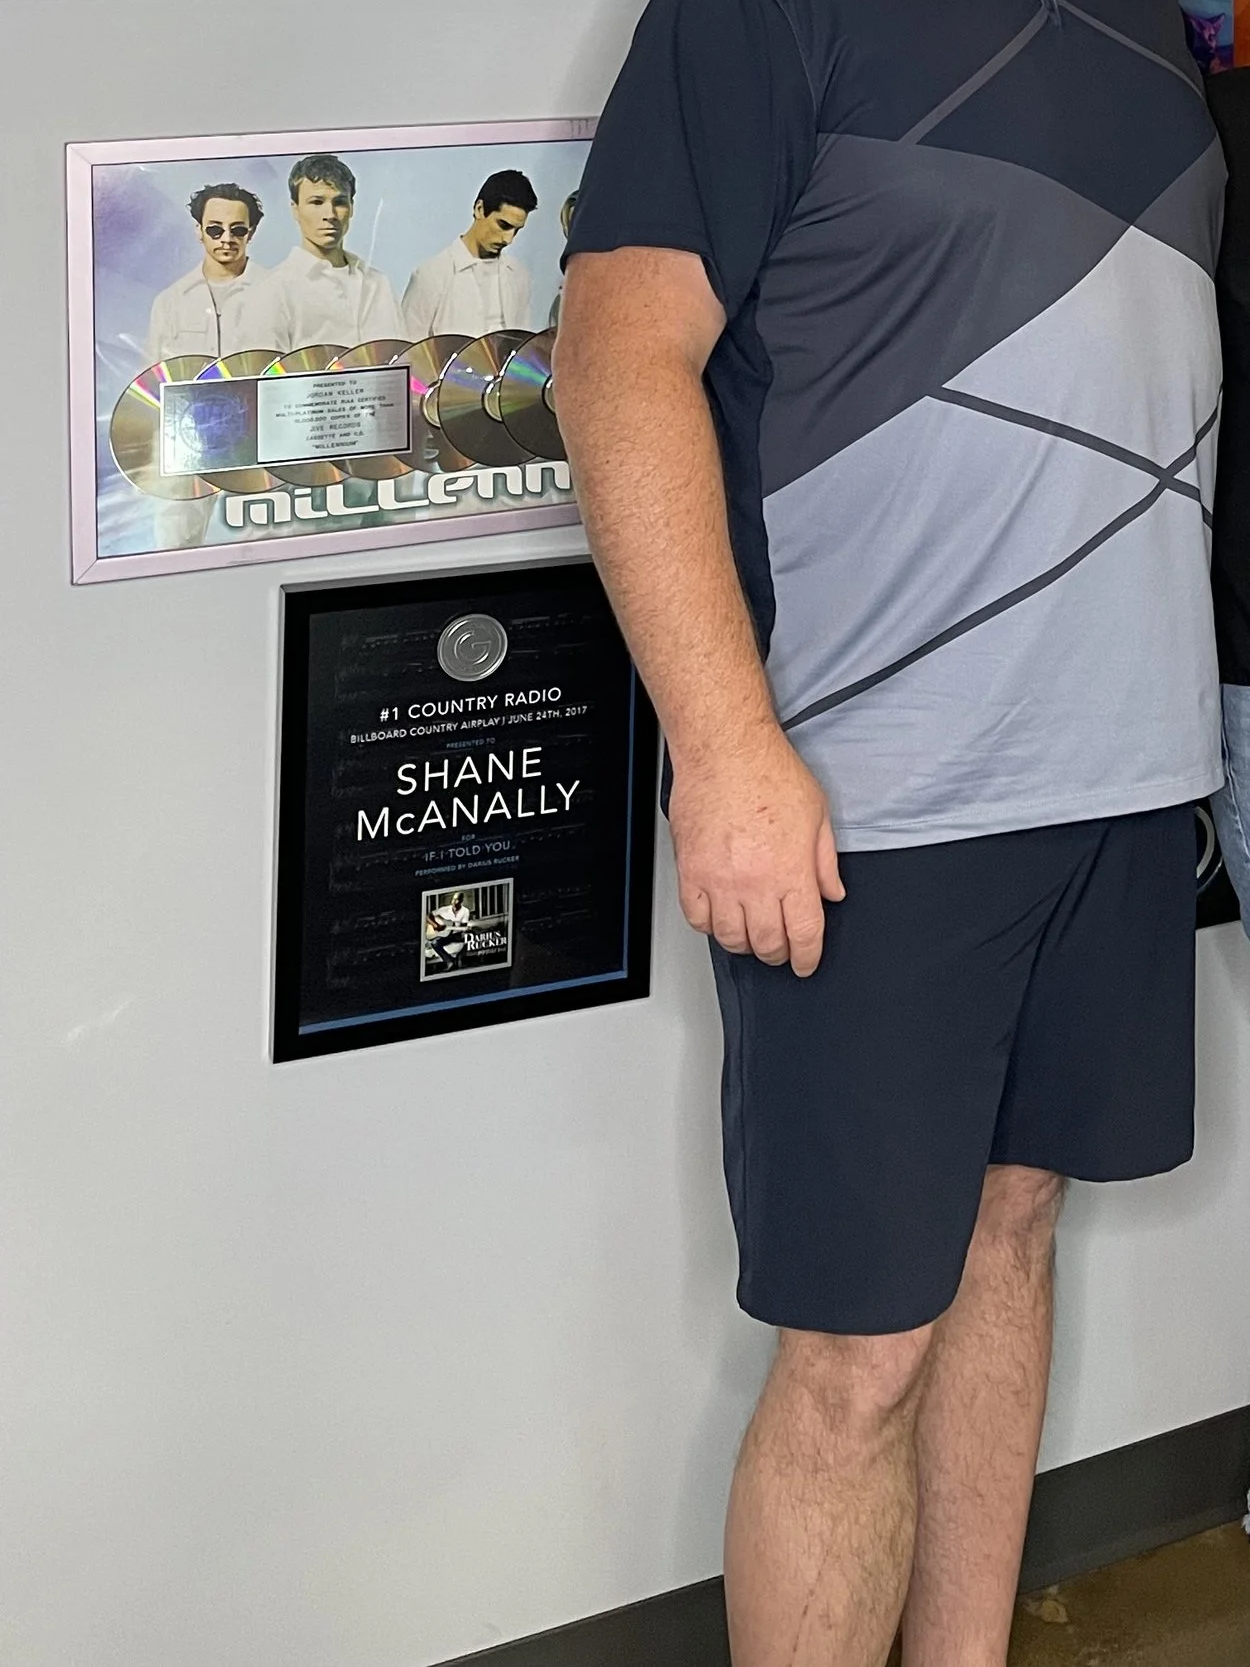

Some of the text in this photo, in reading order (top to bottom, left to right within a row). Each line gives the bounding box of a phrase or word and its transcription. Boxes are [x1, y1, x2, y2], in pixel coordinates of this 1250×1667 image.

[379, 686, 562, 723] #1 COUNTRY RADIO
[350, 728, 408, 745] BILLBOARD
[409, 721, 459, 737] COUNTRY
[460, 716, 501, 731] AIRPLAY
[507, 712, 534, 725] JUNE
[565, 705, 588, 717] 2017
[396, 746, 543, 797] SHANE
[356, 780, 581, 842] McANALLY
[448, 845, 482, 859] TOLD
[484, 839, 511, 853] YOU
